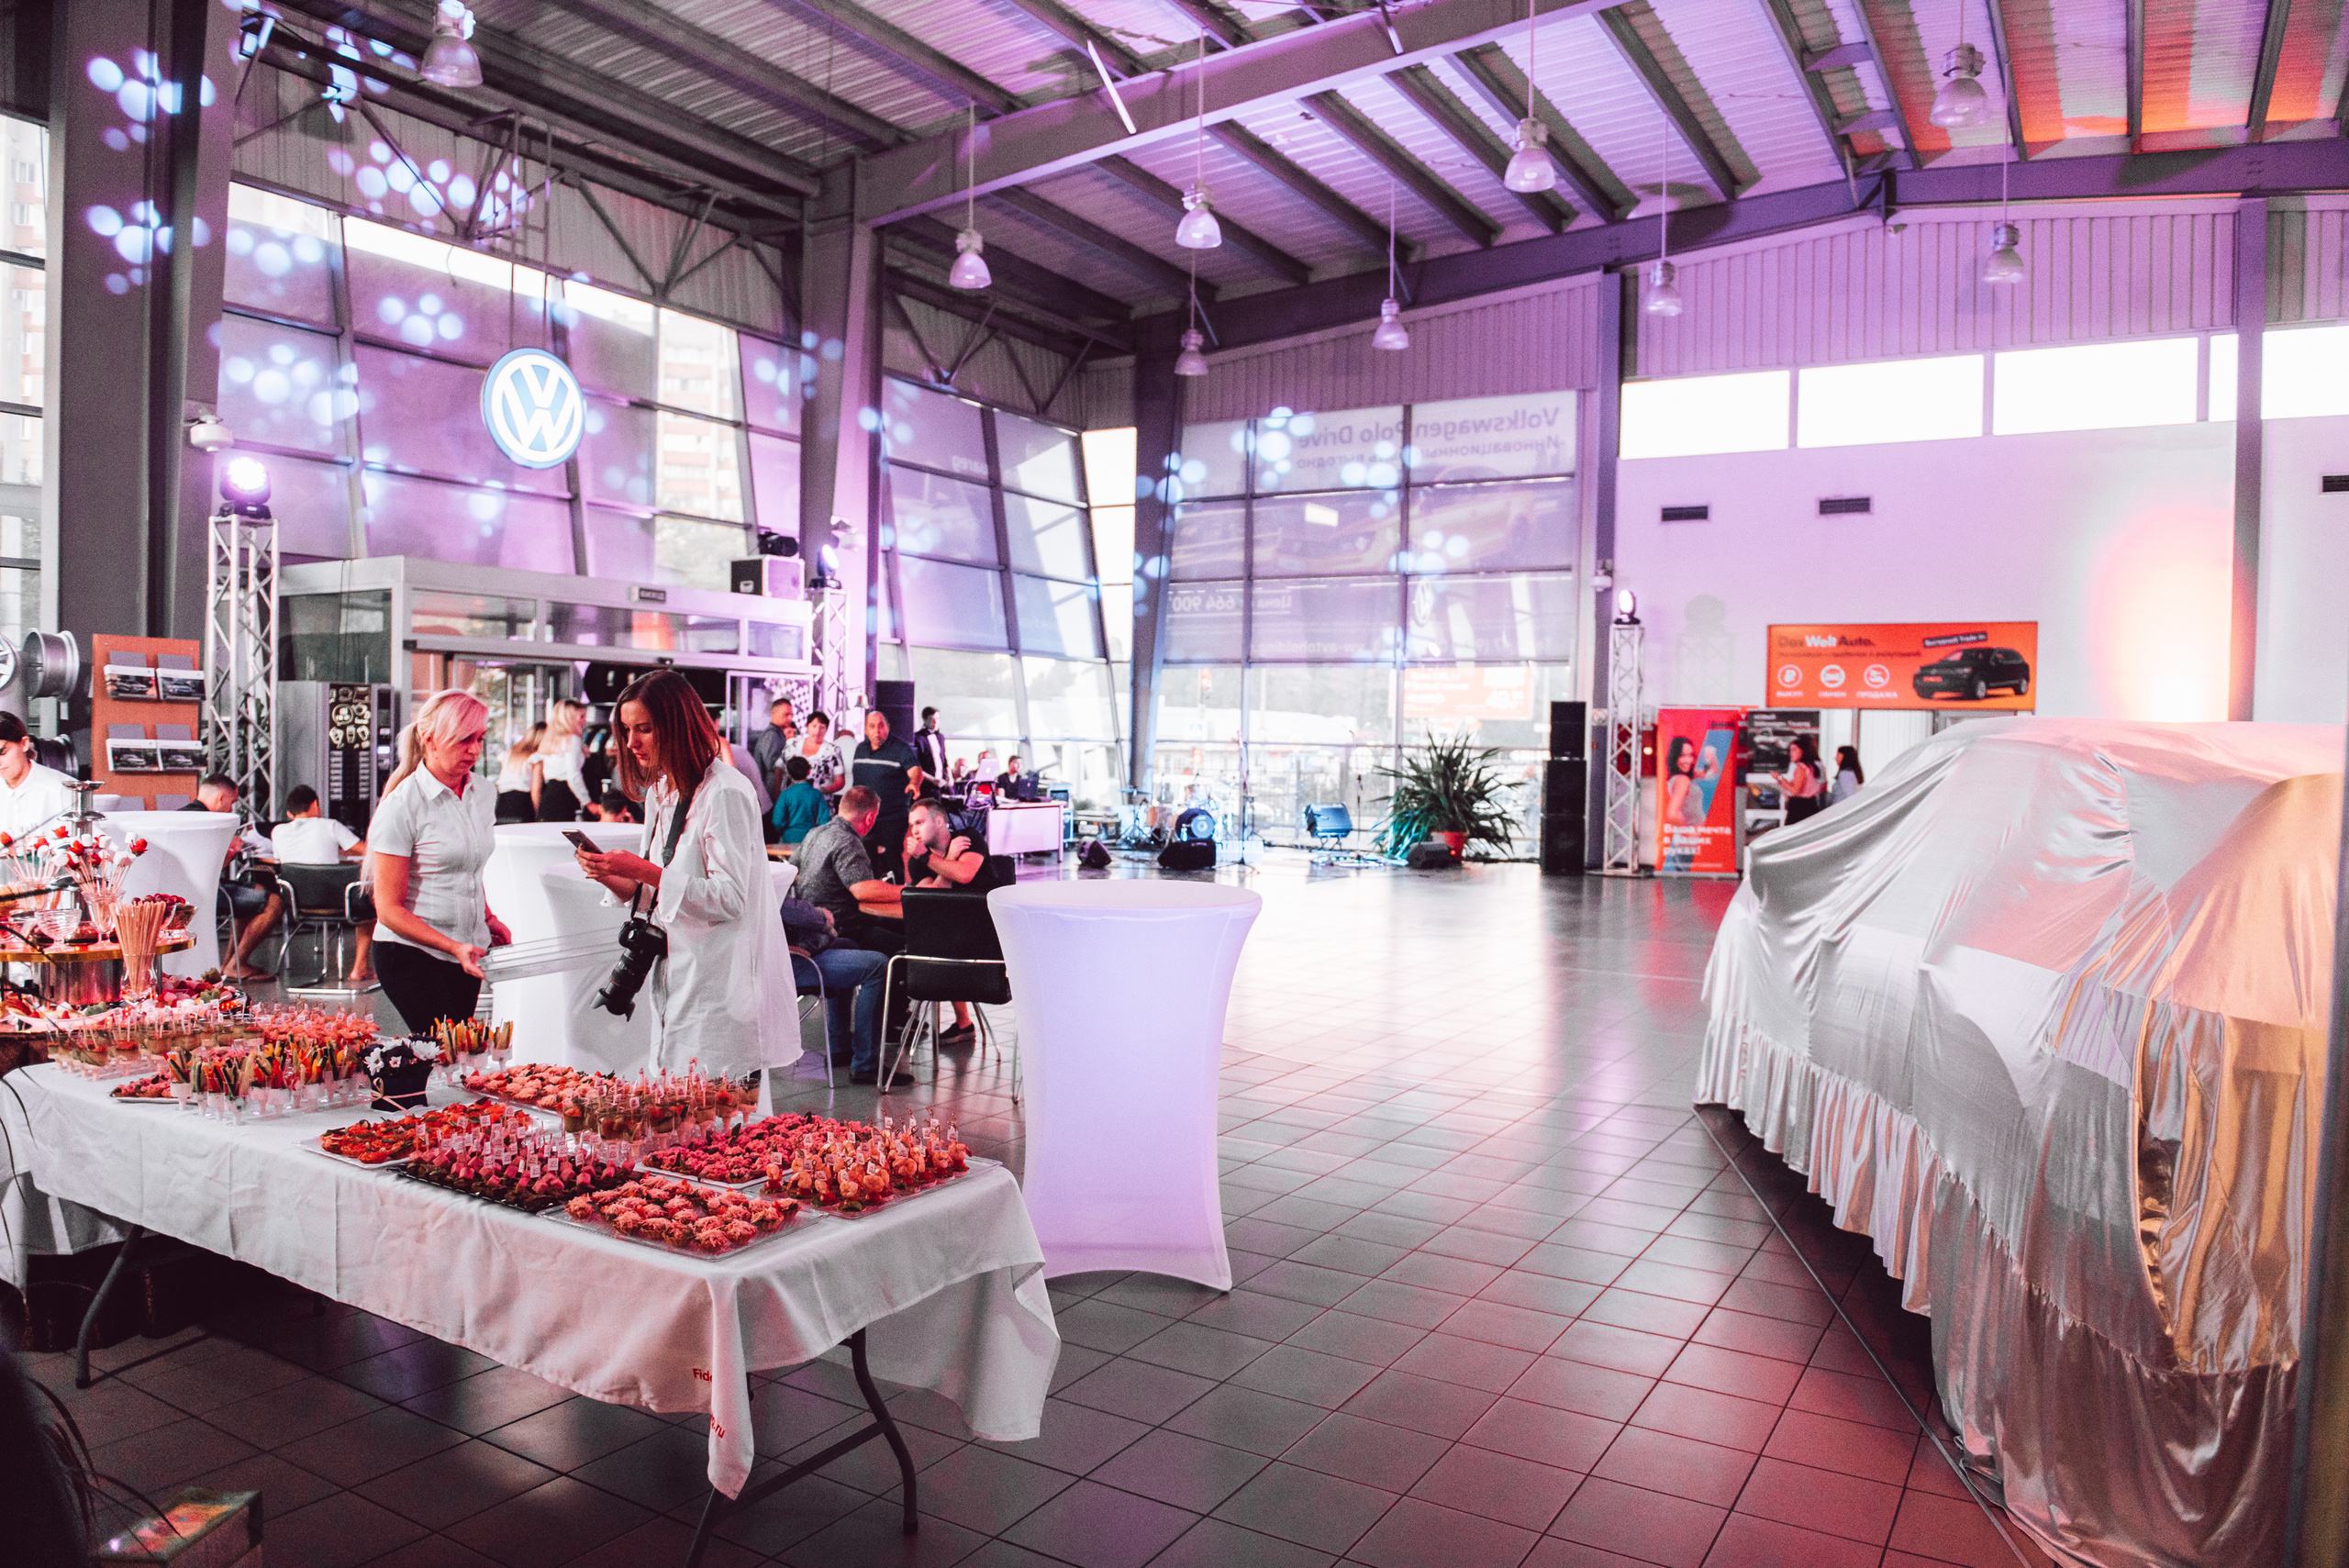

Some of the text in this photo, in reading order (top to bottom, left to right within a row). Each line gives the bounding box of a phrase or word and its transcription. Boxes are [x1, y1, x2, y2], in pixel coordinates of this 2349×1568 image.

[489, 353, 584, 462] VW
[1778, 635, 1805, 648] Das
[1805, 635, 1837, 647] Welt
